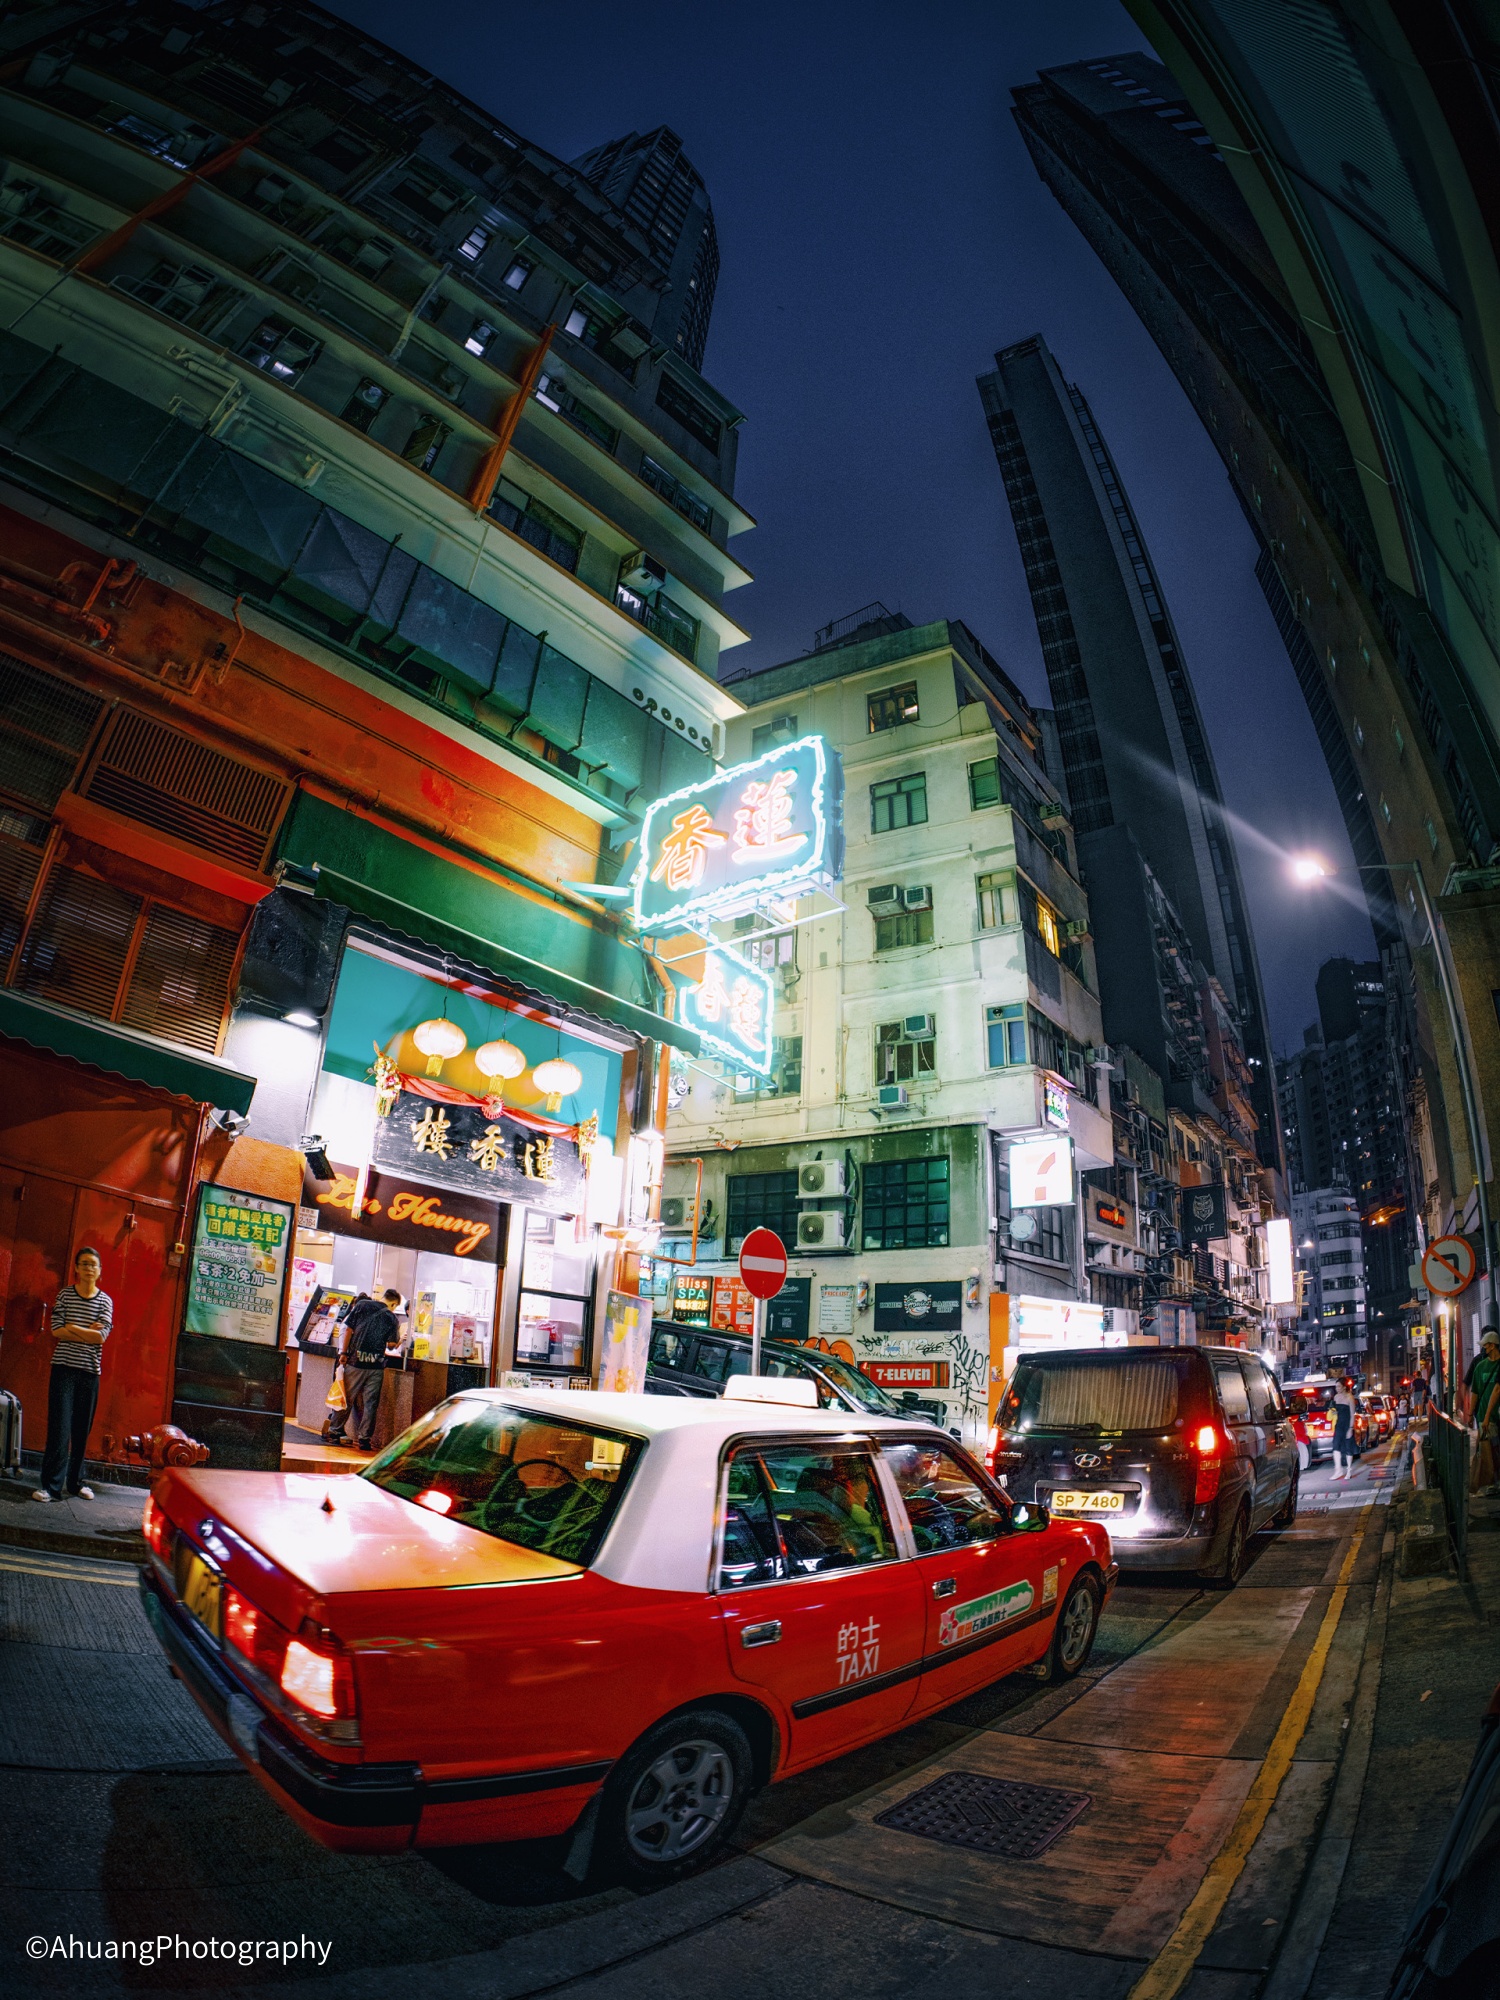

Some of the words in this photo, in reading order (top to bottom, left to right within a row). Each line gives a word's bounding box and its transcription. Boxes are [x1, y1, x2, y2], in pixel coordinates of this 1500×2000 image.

[207, 1218, 280, 1243] 回饋老友記
[387, 1190, 491, 1256] Heung
[1194, 1223, 1215, 1233] WTF
[199, 1249, 221, 1261] 06:00
[225, 1254, 247, 1265] 09:45
[677, 1277, 708, 1289] Bliss
[678, 1288, 706, 1300] SPA
[1056, 1494, 1074, 1507] SP
[1080, 1495, 1119, 1508] 7480
[838, 1615, 881, 1654] 的士
[836, 1644, 880, 1685] TAXI
